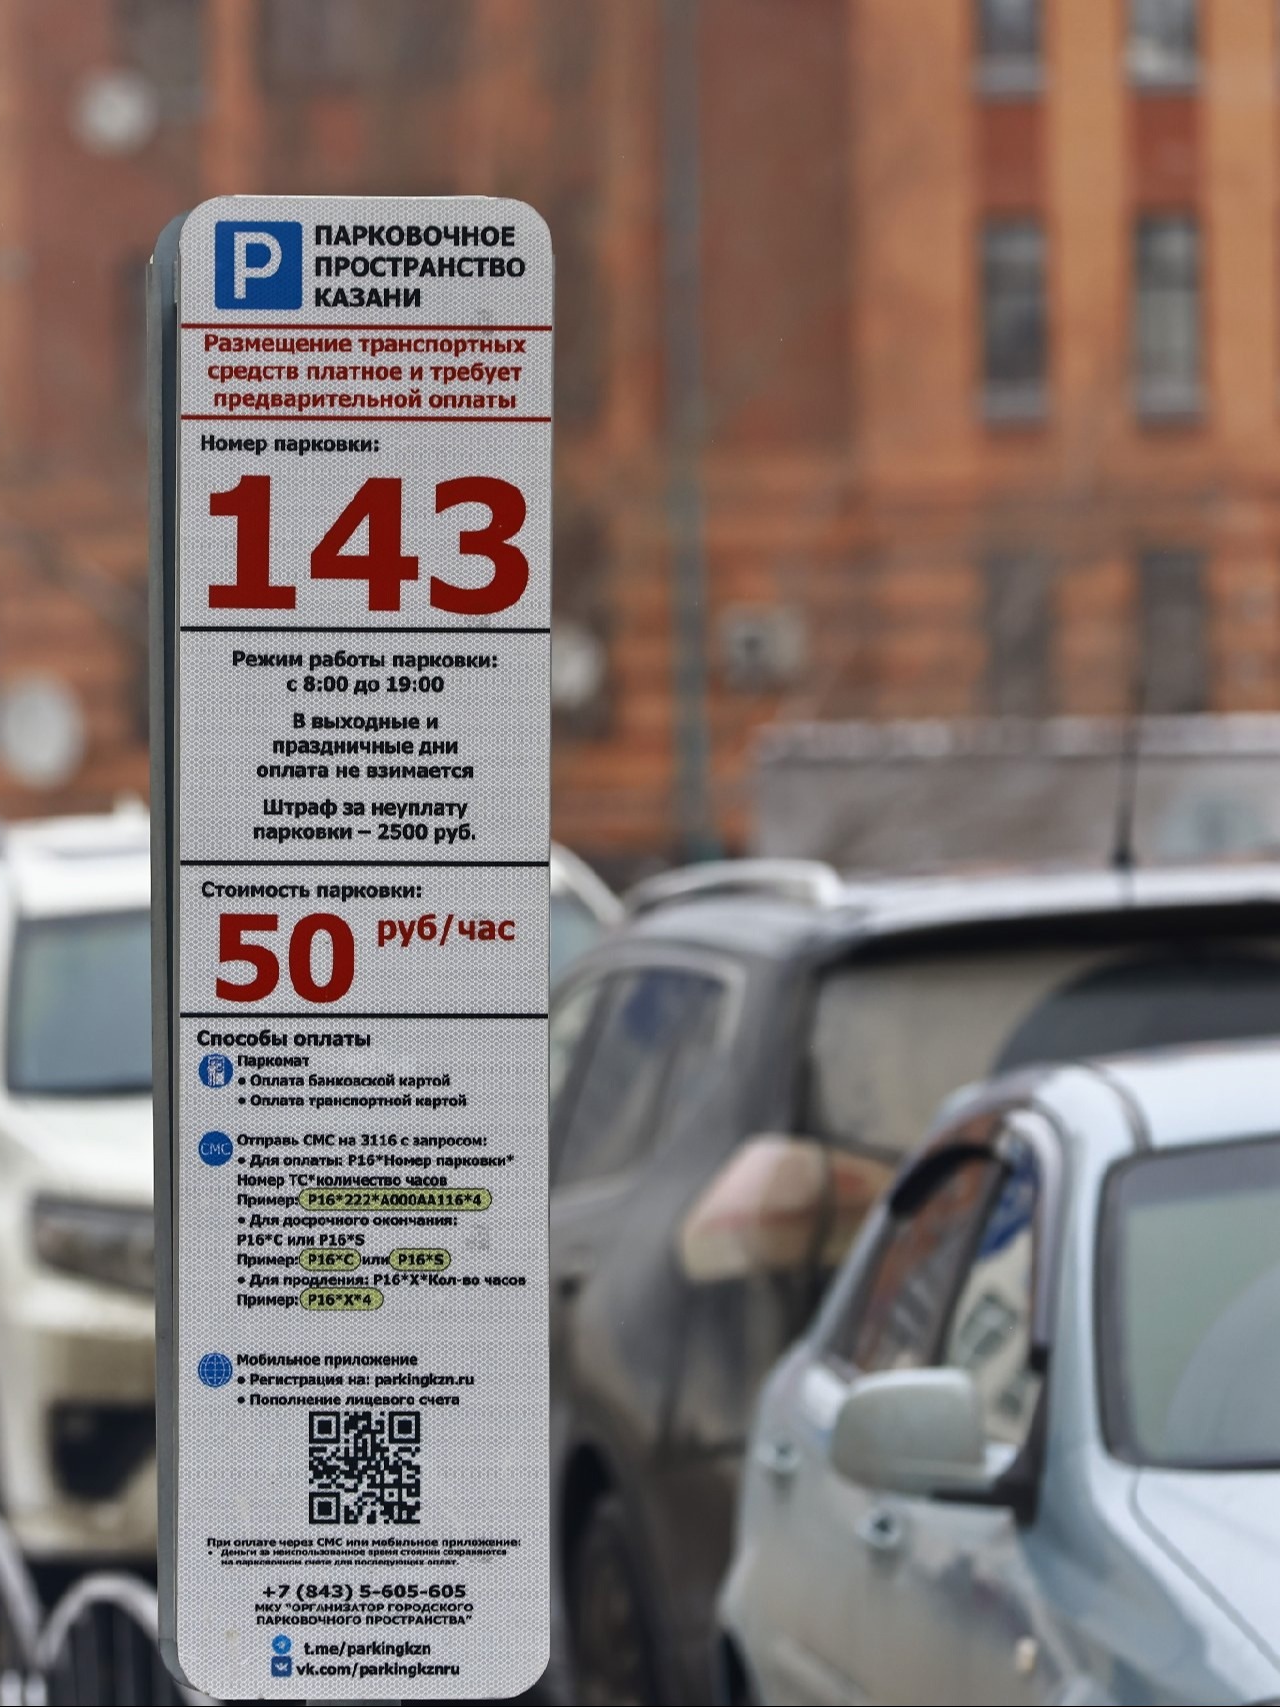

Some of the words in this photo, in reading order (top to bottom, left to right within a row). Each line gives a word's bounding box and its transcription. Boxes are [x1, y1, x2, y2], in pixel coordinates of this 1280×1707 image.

[314, 224, 515, 247] ПАРКОВОЧНОЕ
[233, 230, 283, 300] P
[314, 255, 526, 278] ПРОСТРАНСТВО
[314, 286, 422, 308] КАЗАНИ
[204, 333, 353, 355] Размещение
[357, 337, 526, 358] транспортных
[207, 365, 299, 384] средств
[306, 365, 403, 382] платное
[410, 365, 424, 381] и
[429, 361, 523, 385] требует
[213, 388, 422, 413] предварительной
[428, 393, 517, 409] оплаты
[200, 434, 268, 456] Номер
[274, 438, 380, 457] парковки:
[209, 475, 529, 615] 143
[232, 650, 303, 668] Режим
[309, 649, 386, 672] работы
[392, 654, 498, 673] парковки:
[286, 678, 298, 693] с
[302, 675, 349, 693] 8:00
[353, 679, 381, 696] до
[386, 675, 445, 694] 19:00
[292, 712, 306, 730] В
[311, 715, 420, 733] выходные
[426, 716, 439, 730] и
[272, 739, 414, 757] праздничные
[418, 740, 459, 757] дни
[256, 764, 329, 779] оплата
[335, 765, 360, 779] не
[366, 765, 474, 780] взимается
[263, 798, 338, 819] Штраф
[342, 801, 366, 817] за
[371, 801, 468, 820] неуплату
[253, 826, 353, 844] парковки
[377, 822, 429, 841] 2500
[433, 822, 476, 845] руб.
[201, 880, 311, 899] Стоимость
[316, 884, 422, 903] парковки:
[377, 913, 516, 948] руб/час
[216, 913, 354, 1003] 50
[196, 1028, 288, 1047] Способы
[293, 1033, 371, 1048] оплаты
[237, 1054, 310, 1070] Паркомат
[249, 1073, 305, 1087] Оплата
[308, 1073, 396, 1087] банковской
[398, 1073, 451, 1090] картой
[249, 1093, 305, 1107] Оплата
[308, 1093, 412, 1110] транспортной
[415, 1093, 468, 1110] картой
[200, 1142, 231, 1156] СМС
[236, 1133, 300, 1149] Отправь
[302, 1133, 335, 1147] СМС
[338, 1136, 357, 1147] на
[360, 1133, 398, 1147] 3116
[400, 1136, 410, 1147] с
[412, 1136, 487, 1150] запросом:
[249, 1153, 280, 1169] Для
[282, 1156, 343, 1167] оплаты:
[236, 1173, 286, 1189] Номер
[405, 1175, 448, 1189] часов
[236, 1193, 299, 1209] Пример:
[249, 1213, 280, 1229] Для
[282, 1216, 370, 1229] досрочного
[372, 1216, 458, 1227] окончания:
[287, 1235, 315, 1247] или
[236, 1253, 299, 1269] Пример:
[360, 1255, 390, 1266] или
[248, 1273, 280, 1288] Для
[283, 1276, 371, 1290] продления:
[484, 1276, 527, 1287] часов
[236, 1293, 299, 1309] Пример:
[236, 1353, 321, 1367] Мобильное
[324, 1355, 418, 1369] приложение
[249, 1372, 344, 1388] Регистрация
[347, 1375, 370, 1386] на:
[374, 1372, 475, 1389] parkingkzn.ru
[249, 1393, 342, 1406] Пополнение
[344, 1395, 415, 1408] лицевого
[418, 1395, 460, 1406] счета
[206, 1537, 231, 1549] При
[233, 1539, 277, 1548] оплате
[278, 1538, 314, 1549] через
[316, 1537, 343, 1548] СМС
[345, 1539, 370, 1547] или
[371, 1536, 439, 1548] мобильное
[441, 1538, 521, 1549] приложение:
[262, 1584, 291, 1599] +7
[295, 1583, 353, 1603] (843)
[359, 1583, 467, 1599] 5-605-605
[254, 1603, 282, 1613] МКУ
[387, 1602, 474, 1614] ГОРОДСКОГО
[256, 1614, 362, 1626] ПАРКОВОЧНОГО
[303, 1641, 431, 1658] t.me/parkingkzn
[296, 1662, 460, 1679] vk.com/parkingkznru
